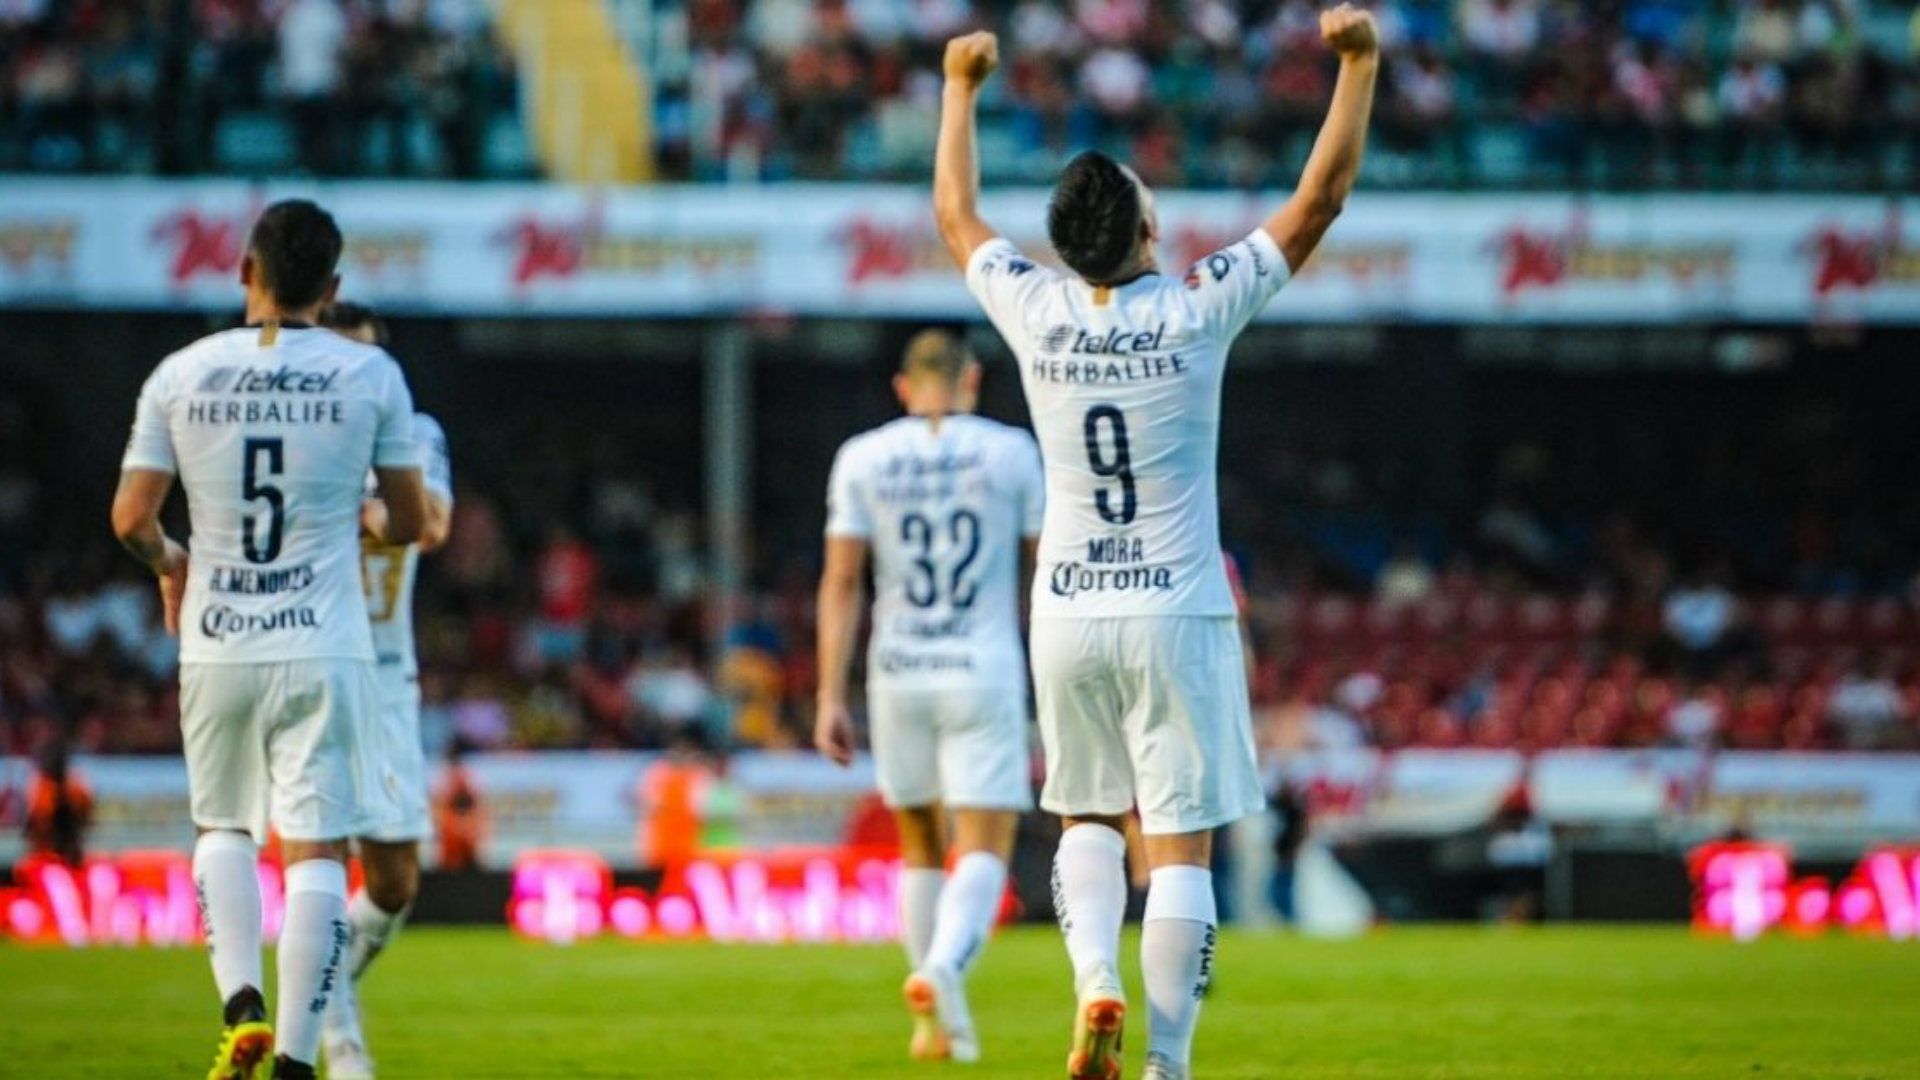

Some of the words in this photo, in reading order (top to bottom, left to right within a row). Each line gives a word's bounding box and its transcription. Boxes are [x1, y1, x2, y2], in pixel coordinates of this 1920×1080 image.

[1072, 321, 1166, 354] telcel
[233, 364, 341, 393] telcel
[1033, 352, 1190, 384] HERBALIFE
[188, 399, 346, 424] HERBALIFE
[1084, 402, 1138, 526] 9
[241, 436, 285, 565] 5
[900, 507, 981, 609] 32
[1087, 537, 1144, 564] MORA
[1051, 561, 1172, 600] Corona
[201, 603, 322, 643] Corona
